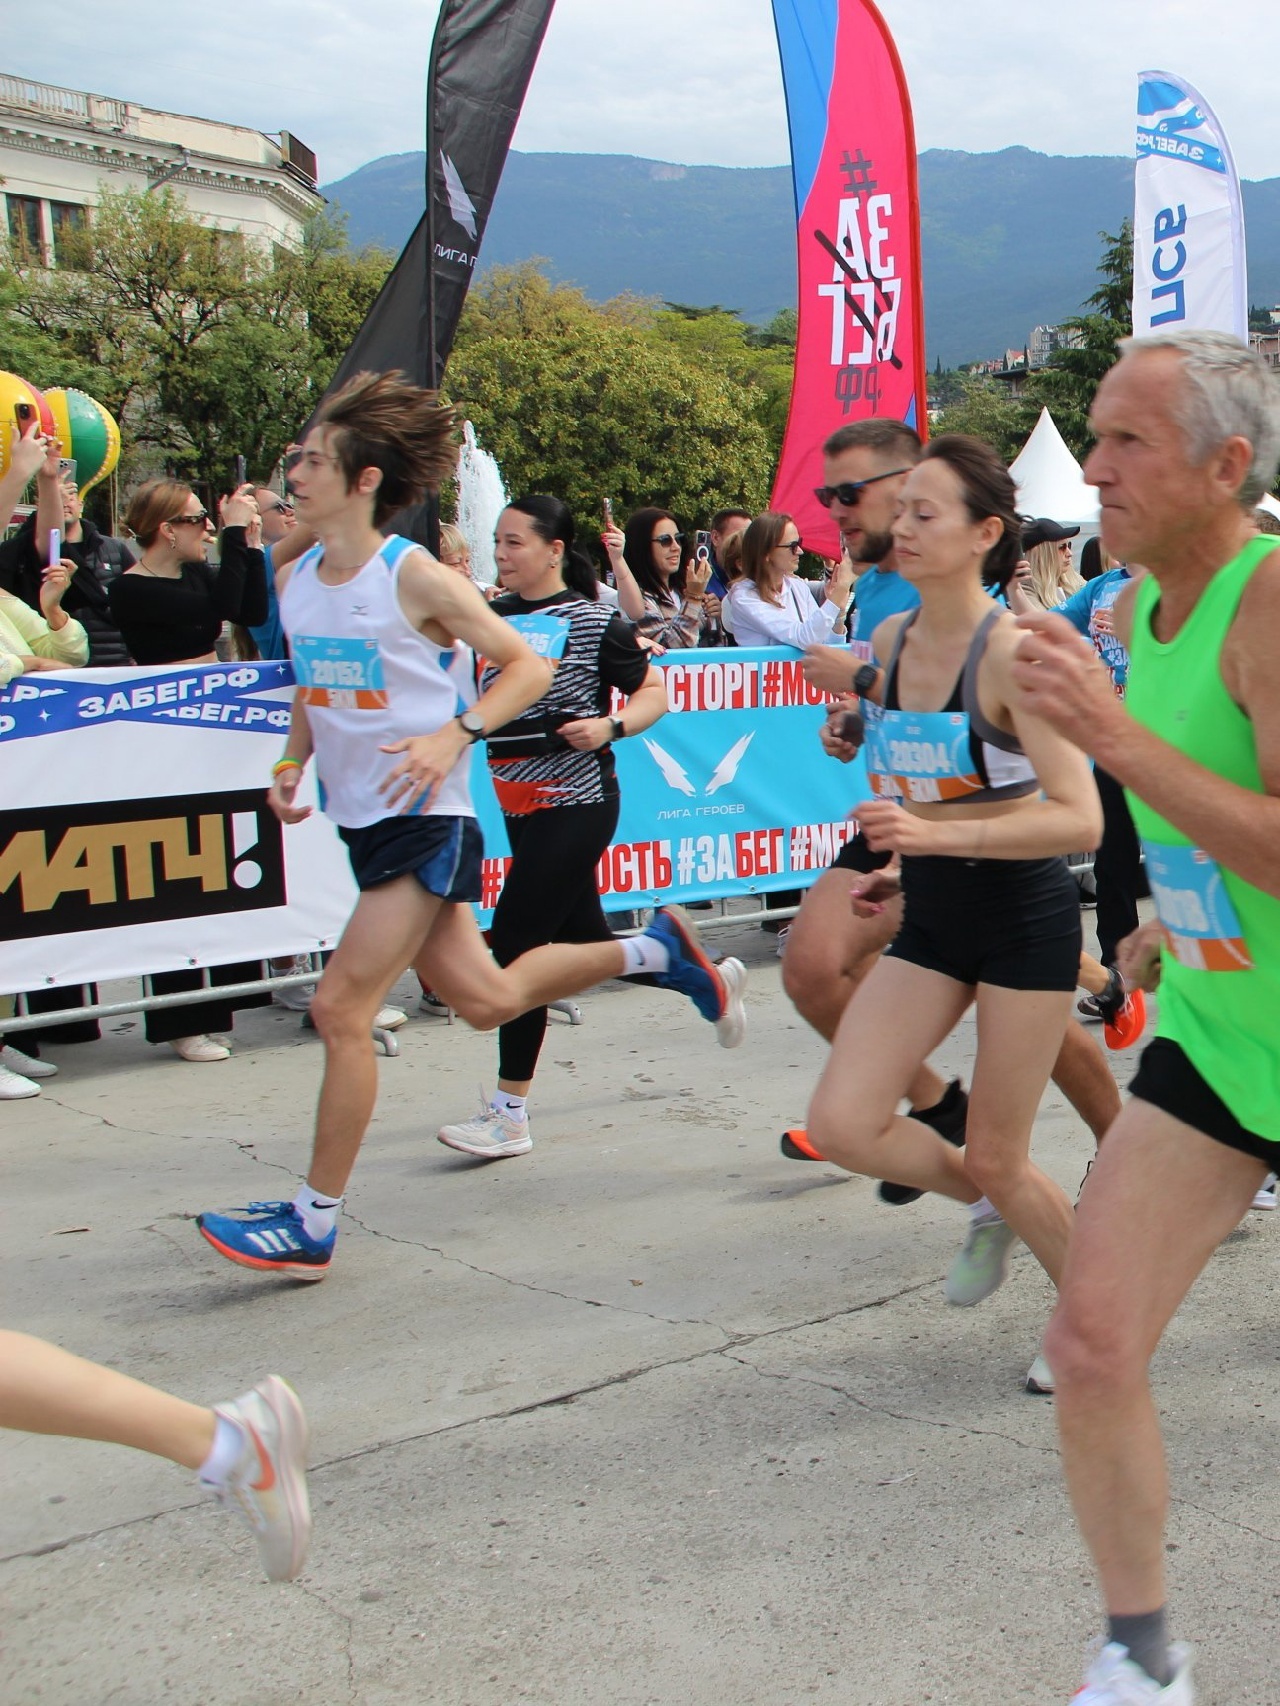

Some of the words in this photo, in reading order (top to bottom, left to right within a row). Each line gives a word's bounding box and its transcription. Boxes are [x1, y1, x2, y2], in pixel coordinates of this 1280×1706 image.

[78, 667, 259, 718] ЗАБЕГ.РФ
[657, 808, 691, 820] ЛИГА
[696, 803, 745, 818] ГЕРОЕВ
[677, 828, 785, 886] #ЗАБЕГ
